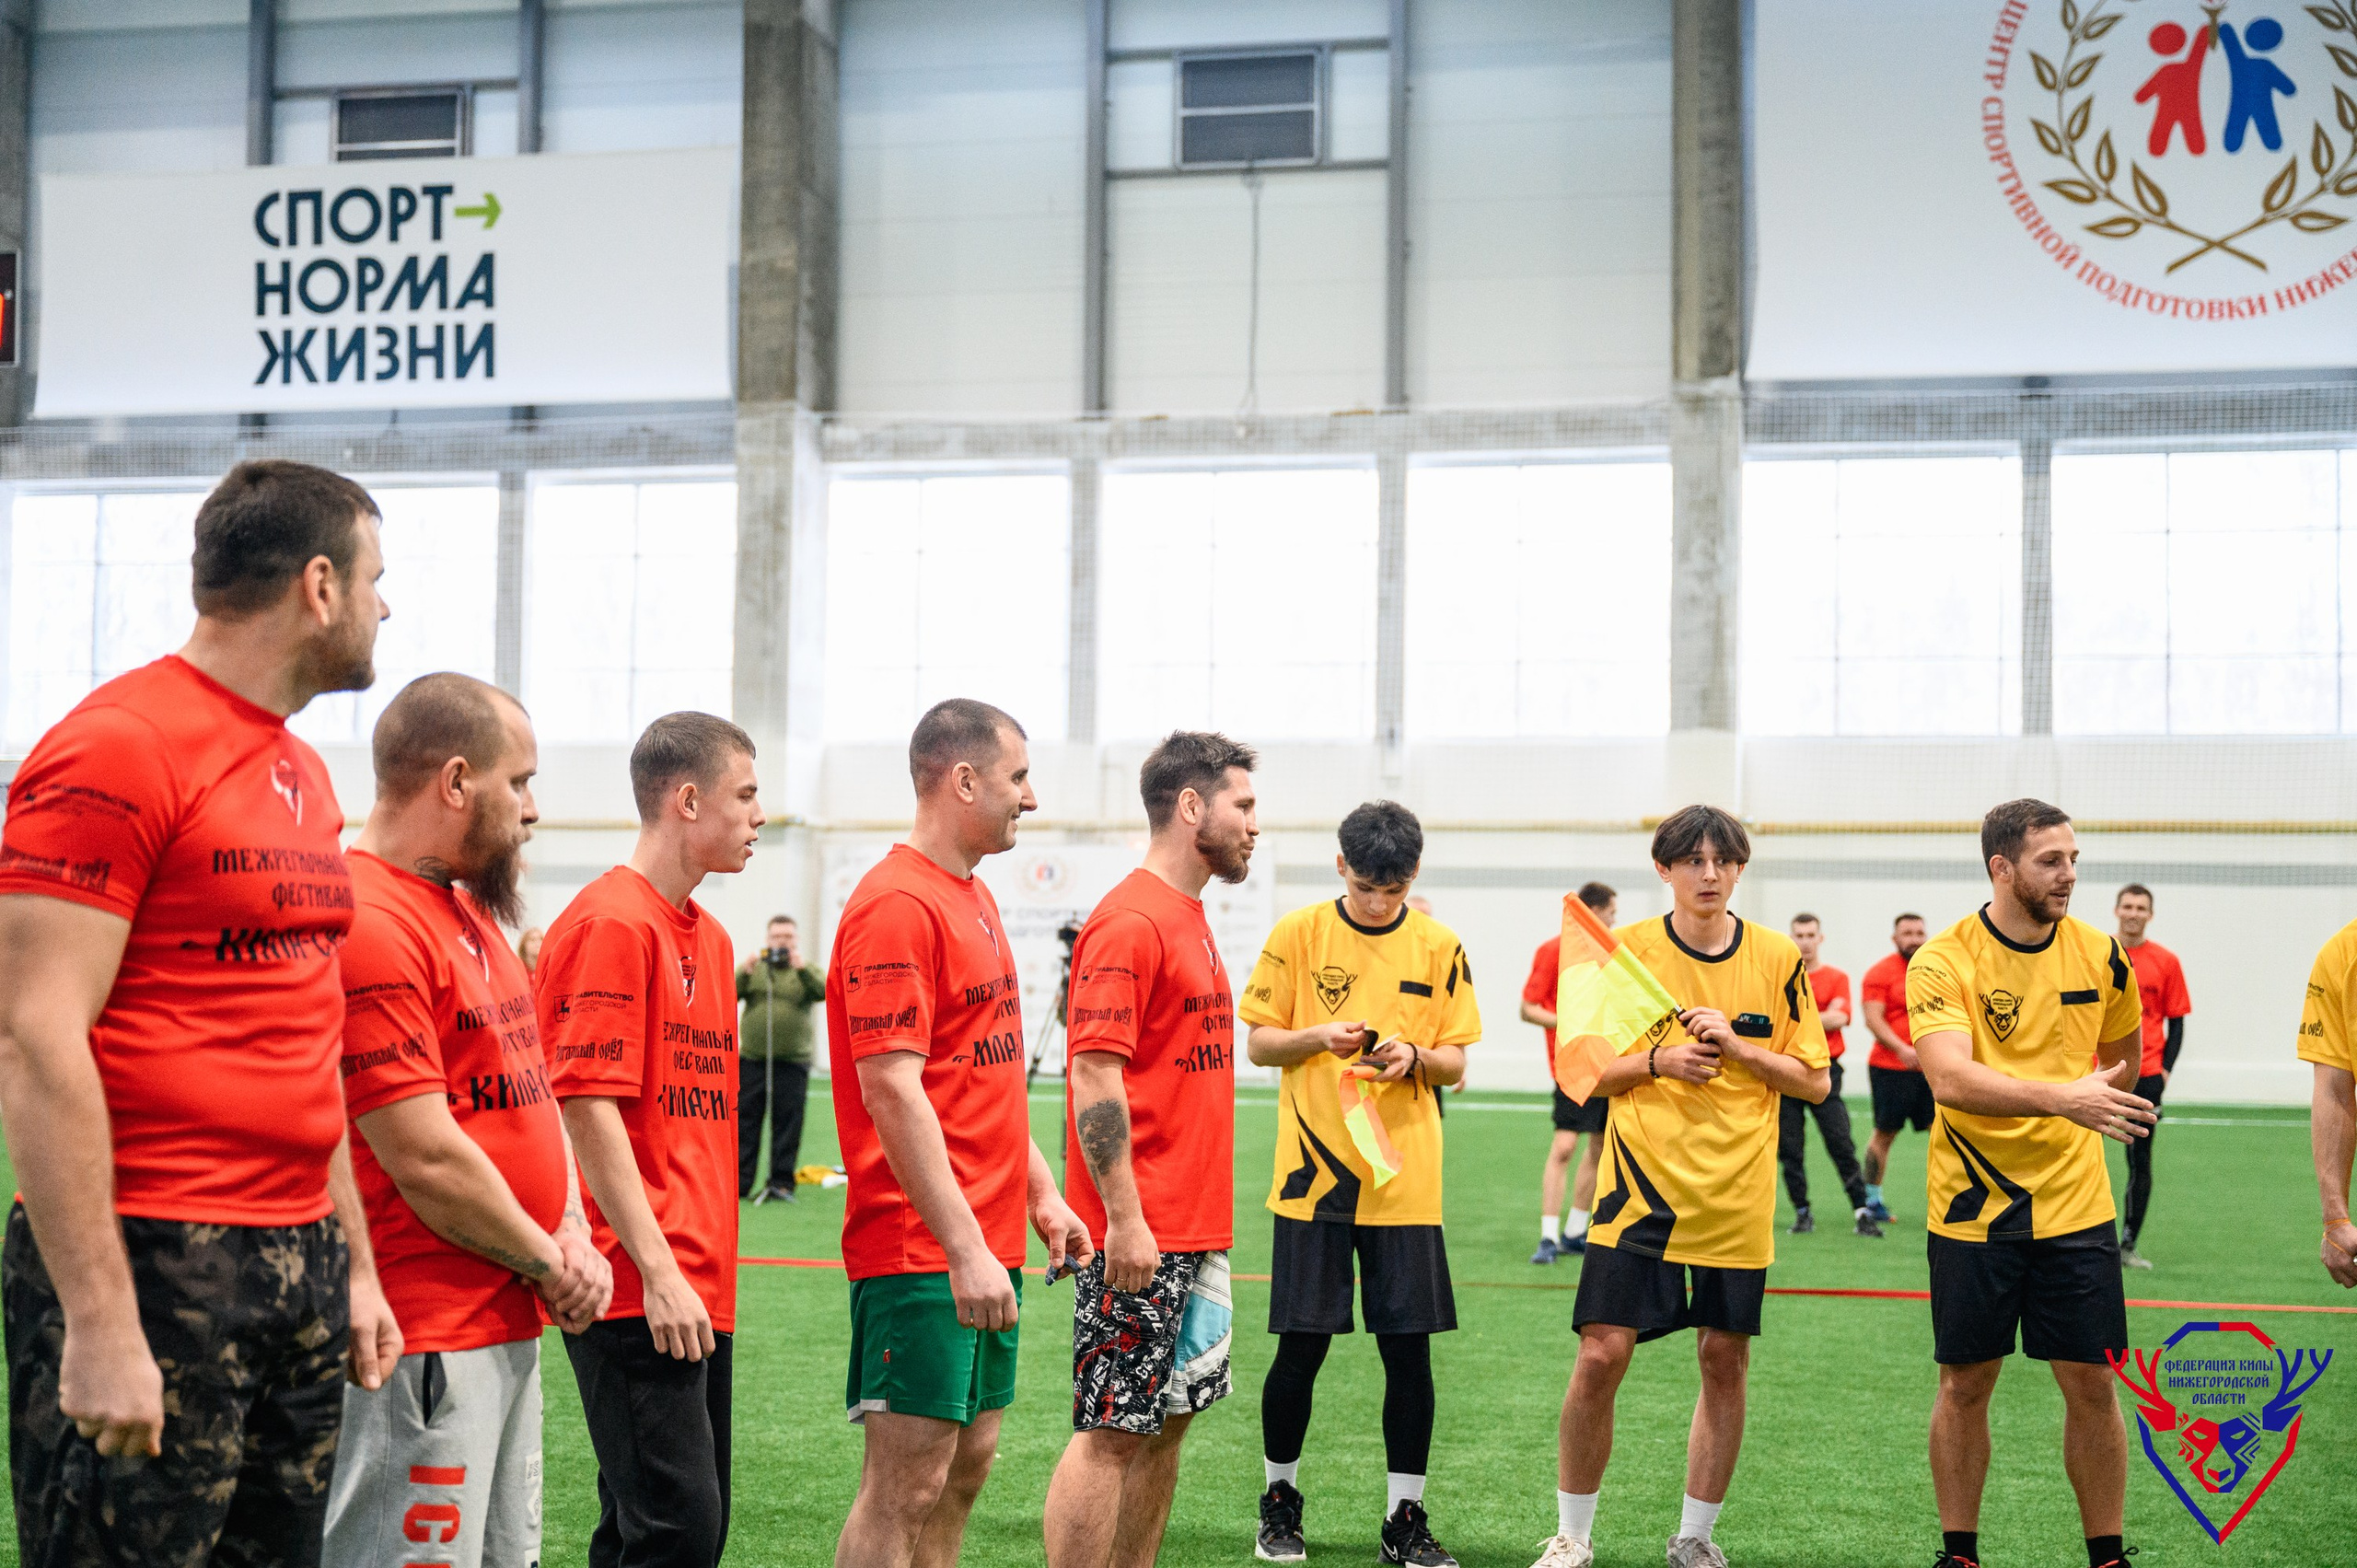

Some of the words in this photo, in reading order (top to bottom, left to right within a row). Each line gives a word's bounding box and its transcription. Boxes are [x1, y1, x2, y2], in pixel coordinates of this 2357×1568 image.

[254, 182, 454, 248] СПОРТ
[1981, 96, 2082, 271] СПОРТИВНОЙ
[2075, 259, 2269, 322] ПОДГОТОВКИ
[2273, 245, 2357, 311] НИЖЕ
[255, 252, 495, 317] НОРМА
[253, 322, 495, 385] ЖИЗНИ
[272, 881, 354, 912] ФЕСТИВАЛ
[575, 990, 634, 1002] АВИТЕЛЬСТВО
[864, 971, 918, 980] НИЖЕГОРОДСКО
[598, 1038, 623, 1062] ОРЁЛ
[673, 1050, 726, 1074] ФЕСВАЛЬ
[402, 1464, 467, 1568] IC
